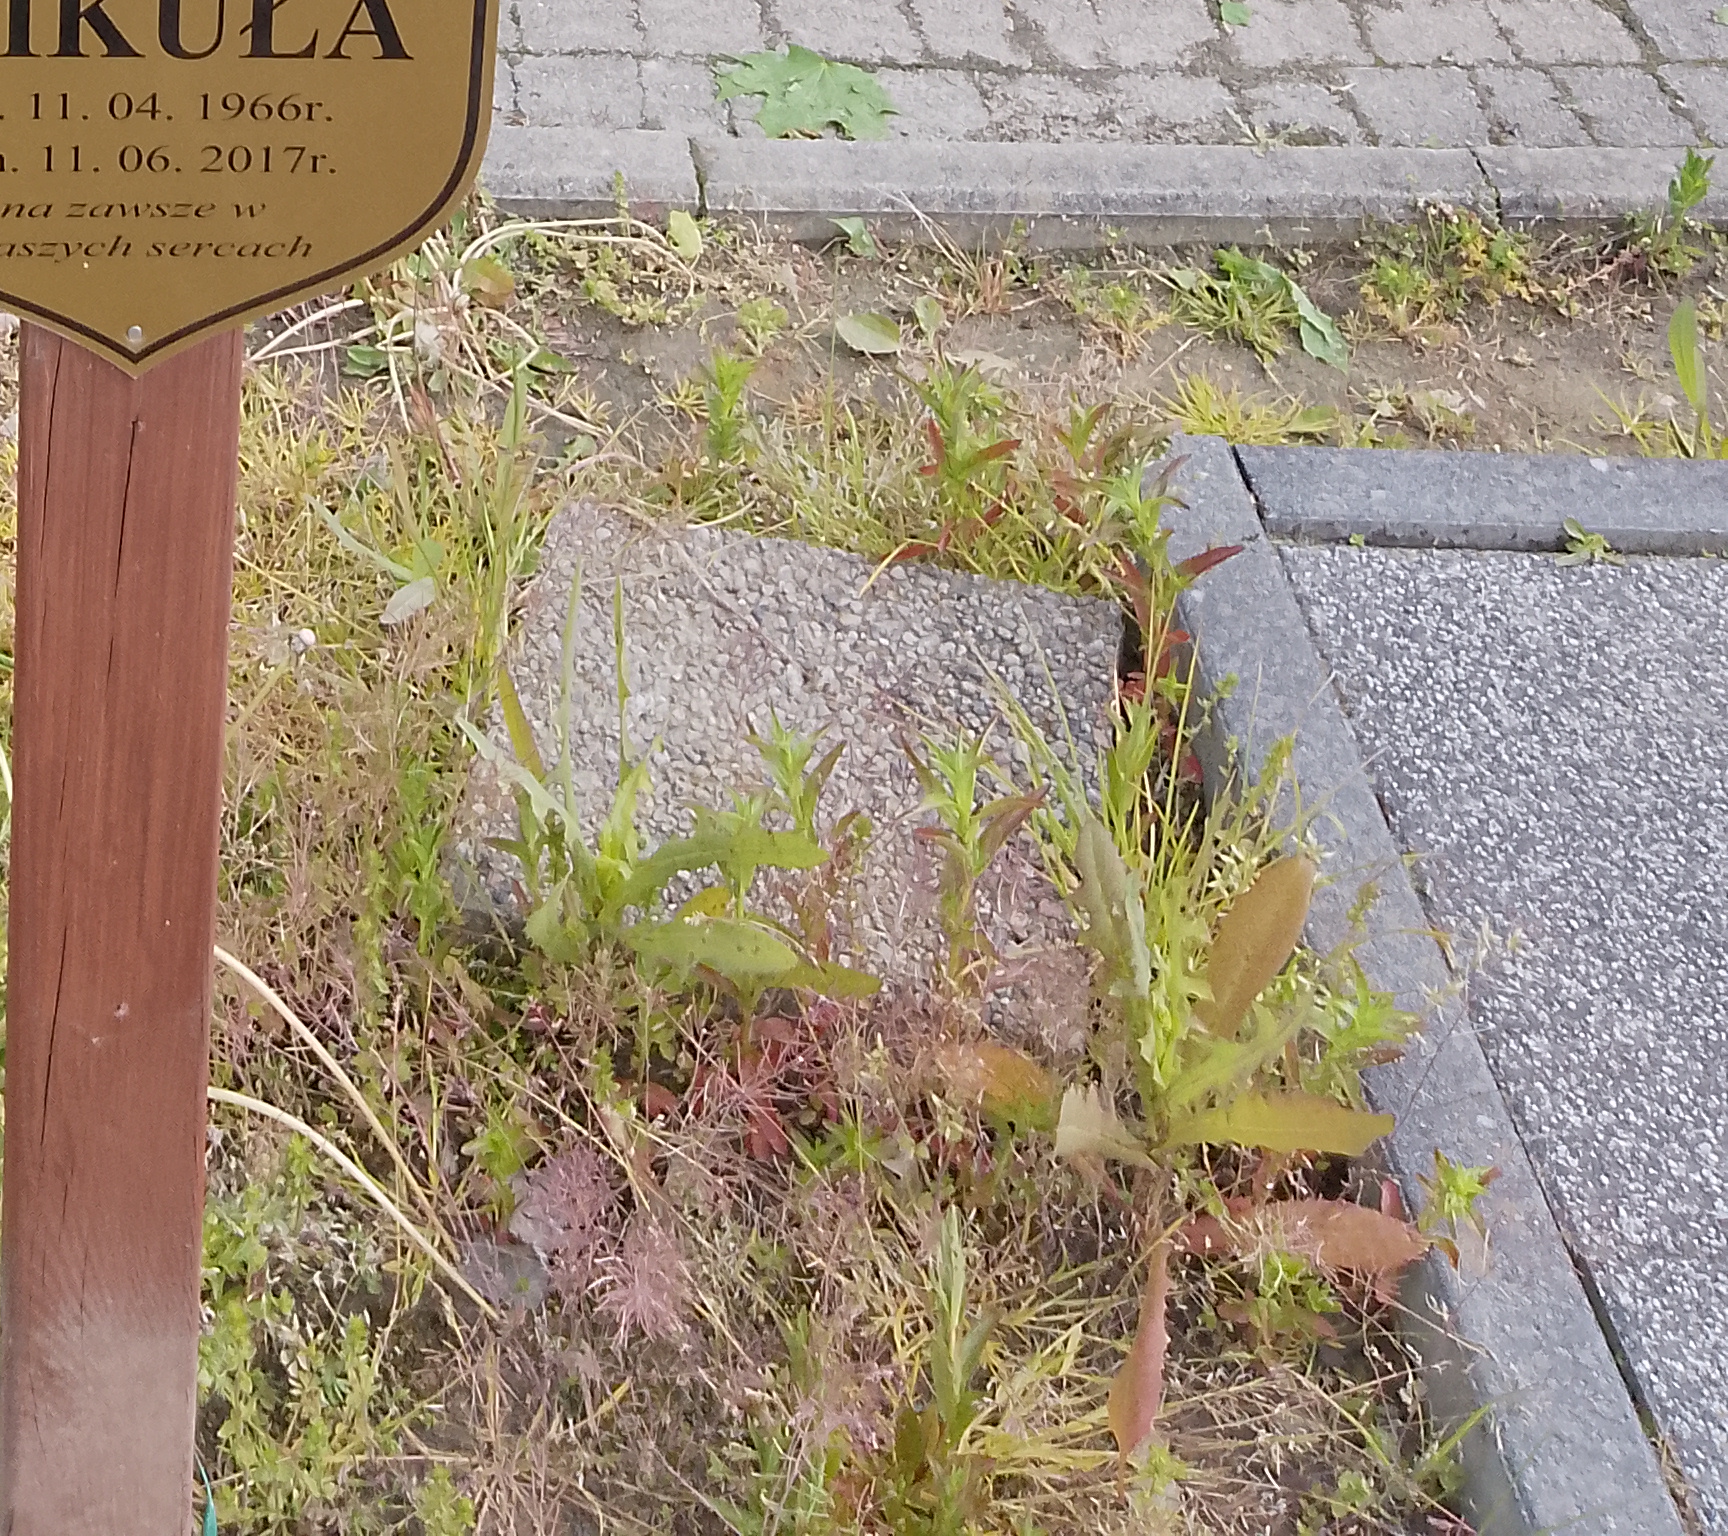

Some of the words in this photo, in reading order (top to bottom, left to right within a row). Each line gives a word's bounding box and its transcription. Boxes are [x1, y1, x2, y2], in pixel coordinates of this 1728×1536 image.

[30, 92, 90, 121] 11.
[108, 92, 175, 122] 04.
[199, 92, 334, 122] 1966r.
[43, 144, 101, 174] 11.
[118, 144, 183, 174] 06.
[200, 144, 338, 175] 2017r.
[0, 201, 53, 219] na
[66, 201, 217, 219] zawsze
[233, 201, 267, 219] w
[146, 235, 314, 259] sercach
